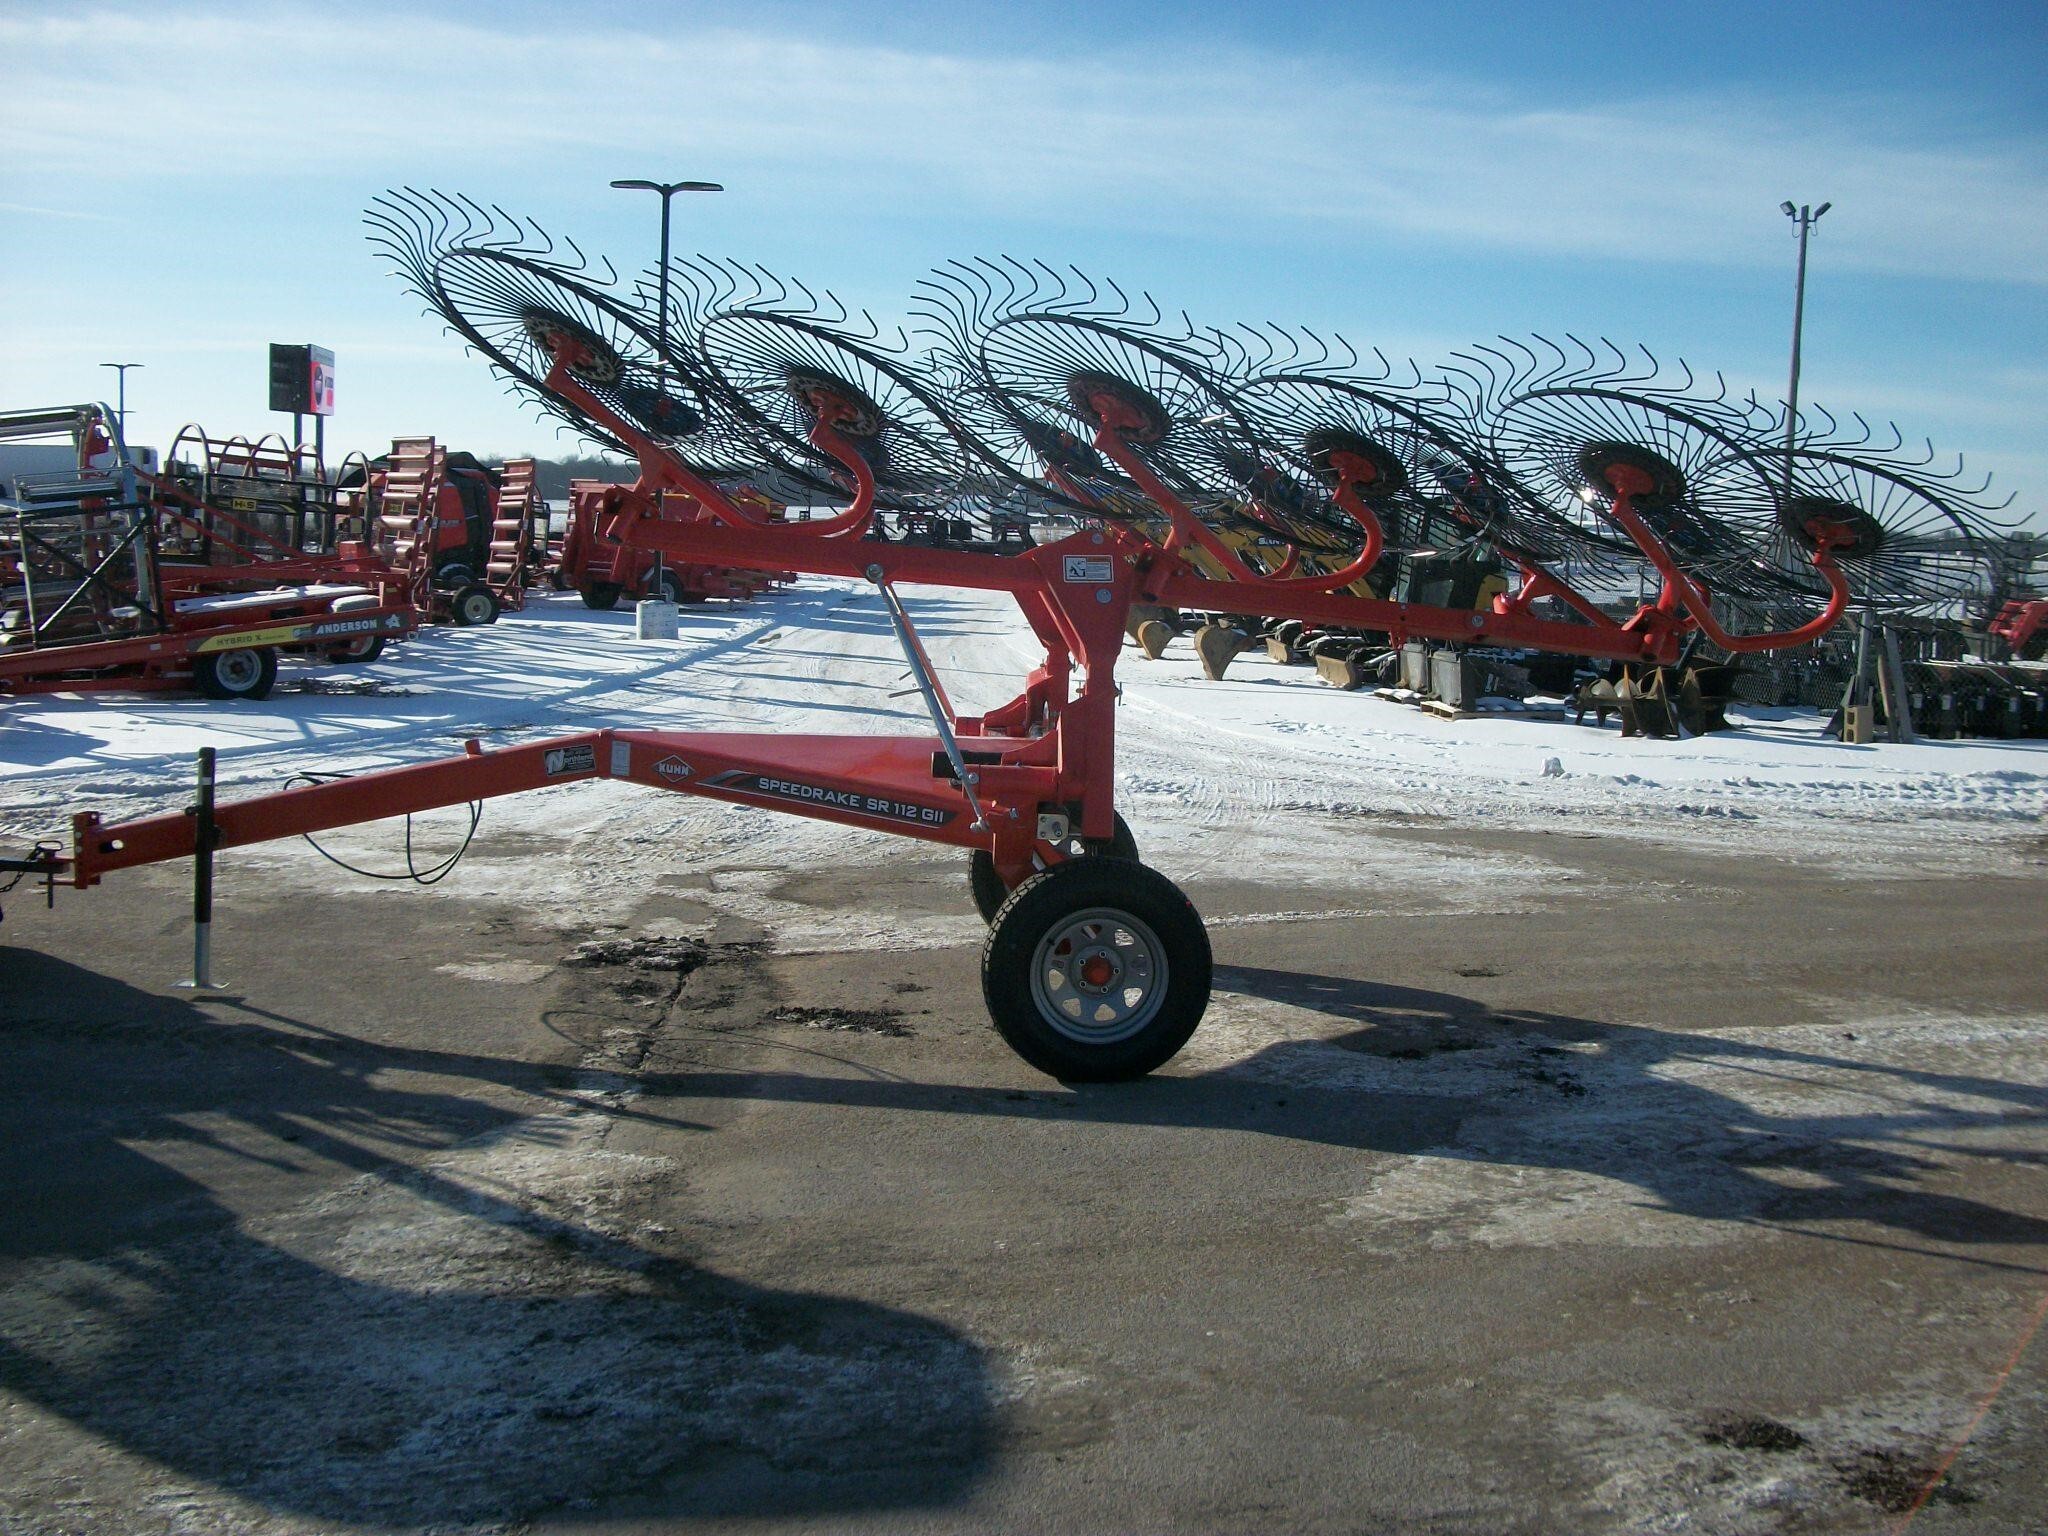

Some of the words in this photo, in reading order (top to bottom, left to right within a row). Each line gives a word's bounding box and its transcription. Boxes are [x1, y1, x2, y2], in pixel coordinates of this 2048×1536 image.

[316, 619, 377, 635] ANDERSON
[216, 636, 252, 646] HYBRID
[658, 763, 689, 776] KUHN
[758, 777, 860, 807] SPEEDRAKE
[866, 798, 889, 813] SR
[894, 803, 917, 818] 112
